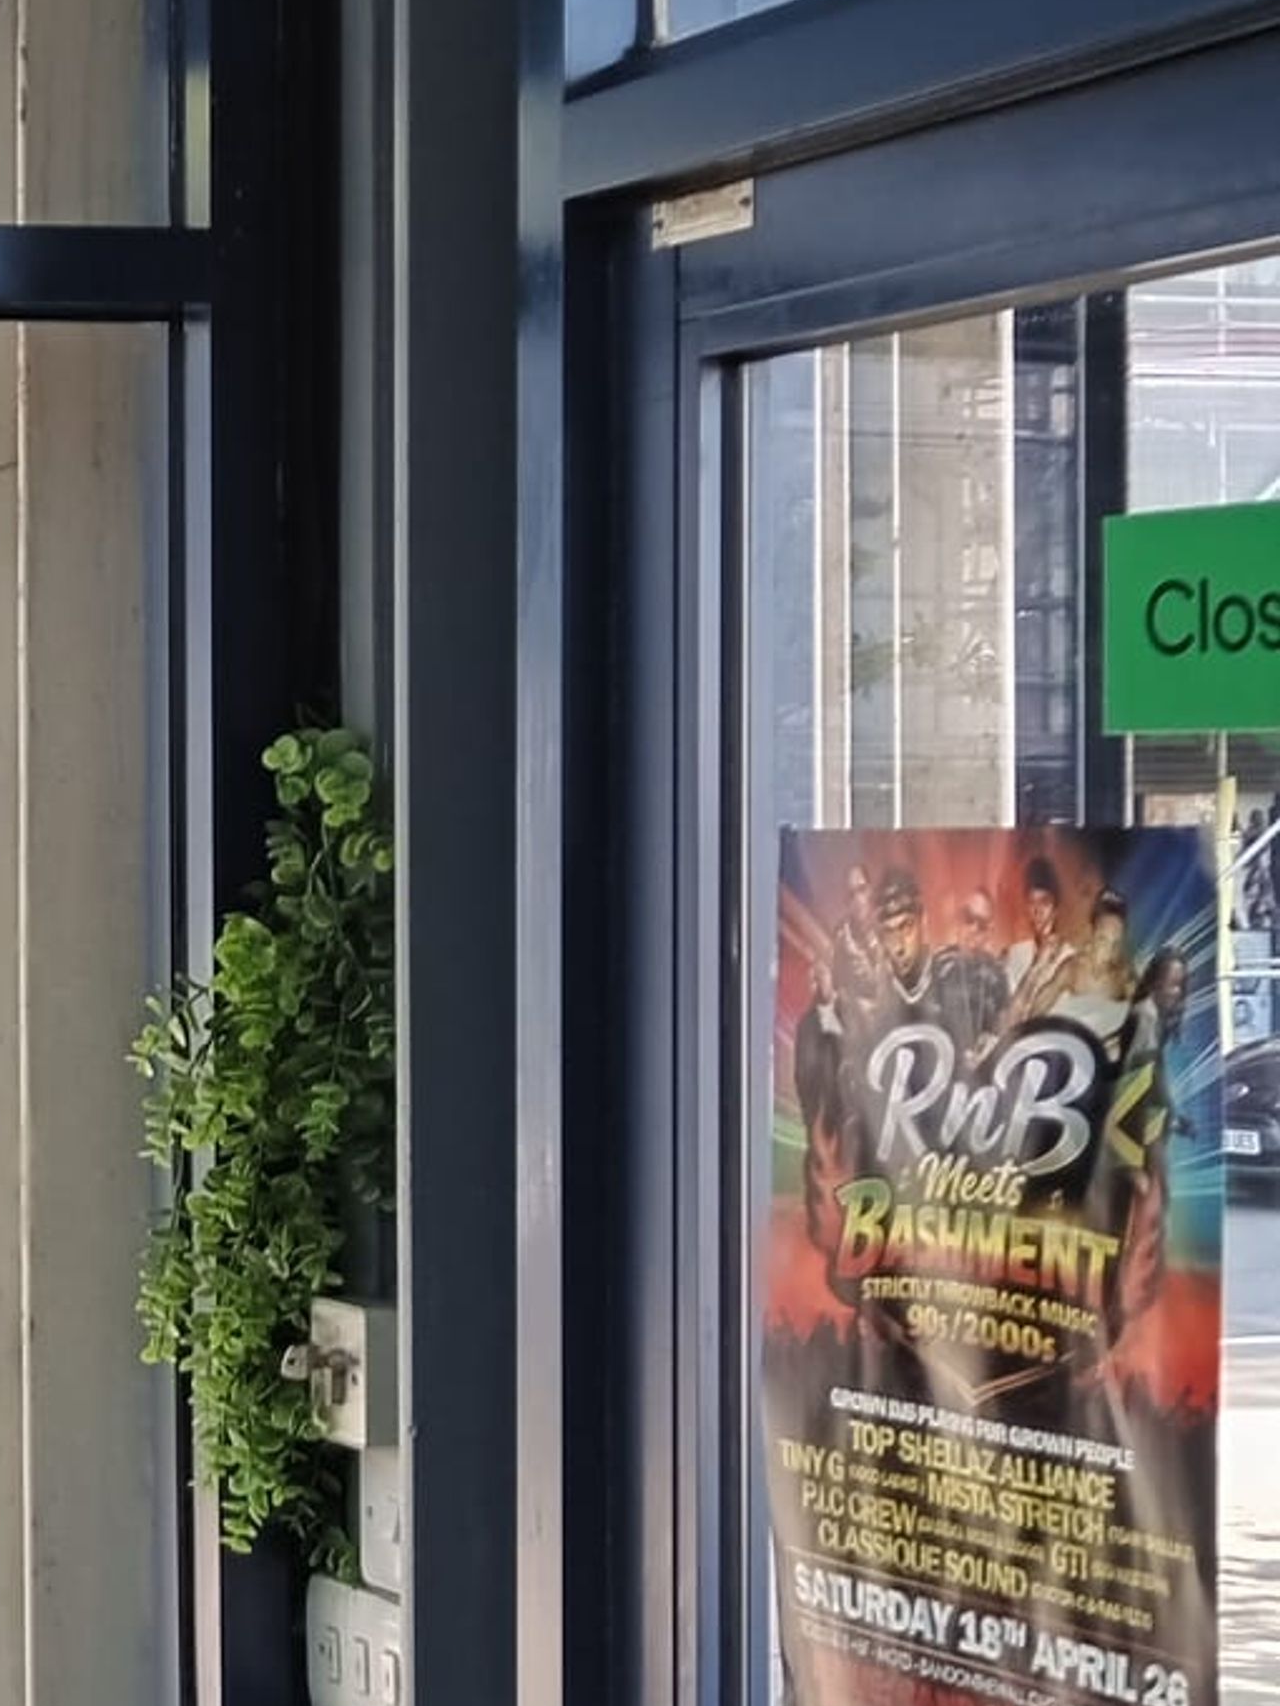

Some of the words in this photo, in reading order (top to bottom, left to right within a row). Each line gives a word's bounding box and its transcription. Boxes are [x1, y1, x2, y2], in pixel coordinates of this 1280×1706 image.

[866, 1030, 1096, 1177] RnB
[917, 1151, 1027, 1207] Meets
[836, 1177, 1119, 1311] BASHMENT
[861, 1277, 937, 1302] STRICTLY
[1039, 1300, 1099, 1337] MUSIC
[849, 1420, 895, 1456] TOP
[999, 1454, 1116, 1510] ALLIANCE
[1075, 1438, 1135, 1471] PEOPLE
[848, 1492, 917, 1534] CREW
[999, 1492, 1105, 1545] STRETCH
[944, 1549, 1028, 1599] SOUND
[794, 1562, 954, 1645] SATURDAY
[1031, 1631, 1138, 1703] APRIL
